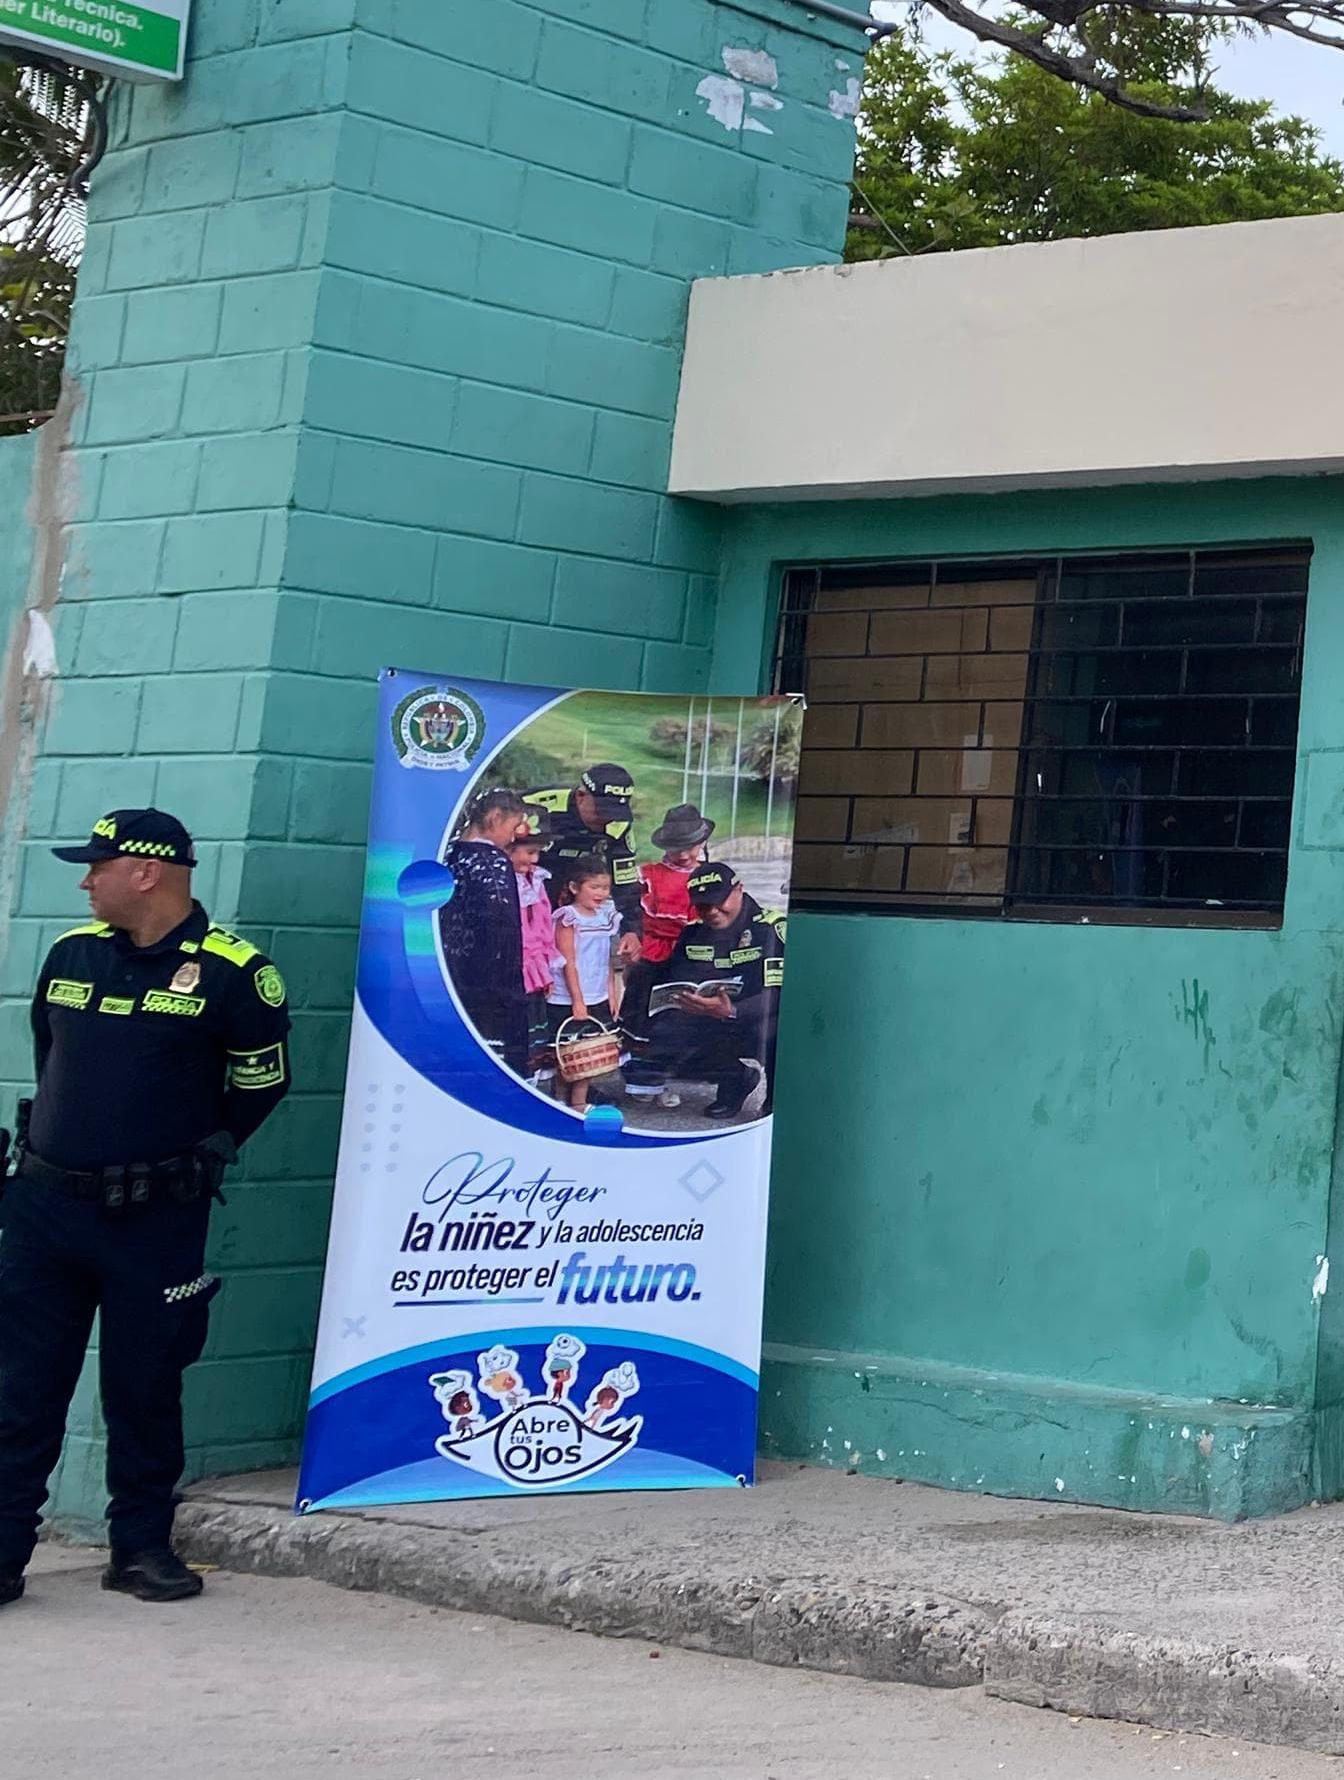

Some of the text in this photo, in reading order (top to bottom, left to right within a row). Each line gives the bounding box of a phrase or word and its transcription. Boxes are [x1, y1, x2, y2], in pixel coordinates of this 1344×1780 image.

[422, 1151, 608, 1223] Proteger
[400, 1211, 705, 1252] la niñez y la adolescencia
[390, 1251, 703, 1306] es proteger el futuro.
[509, 1434, 533, 1445] tus
[510, 1416, 571, 1436] Abre
[503, 1440, 583, 1474] Ojos
